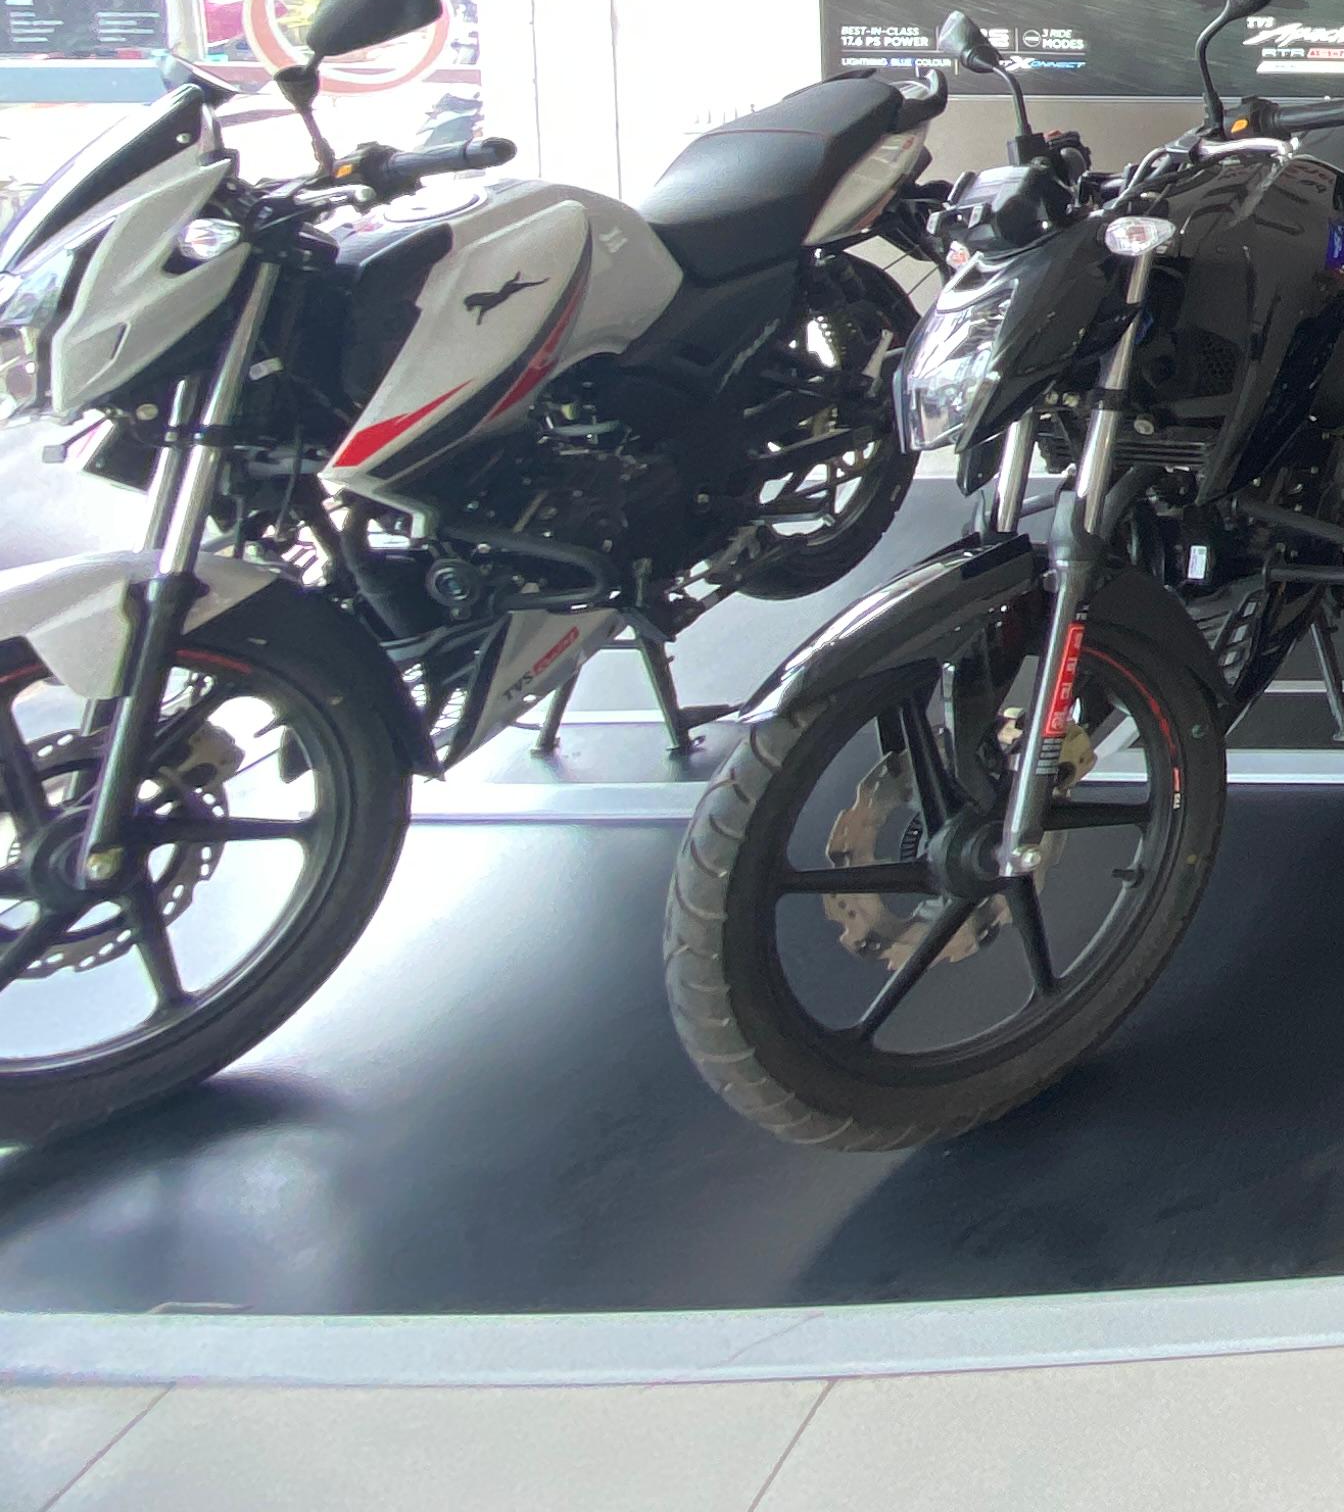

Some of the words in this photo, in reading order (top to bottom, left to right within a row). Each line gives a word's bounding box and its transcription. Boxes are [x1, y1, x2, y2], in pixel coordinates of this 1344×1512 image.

[841, 25, 921, 37] BEST-IN-CLASS
[883, 36, 930, 47] POWER
[1041, 38, 1085, 50] MODES
